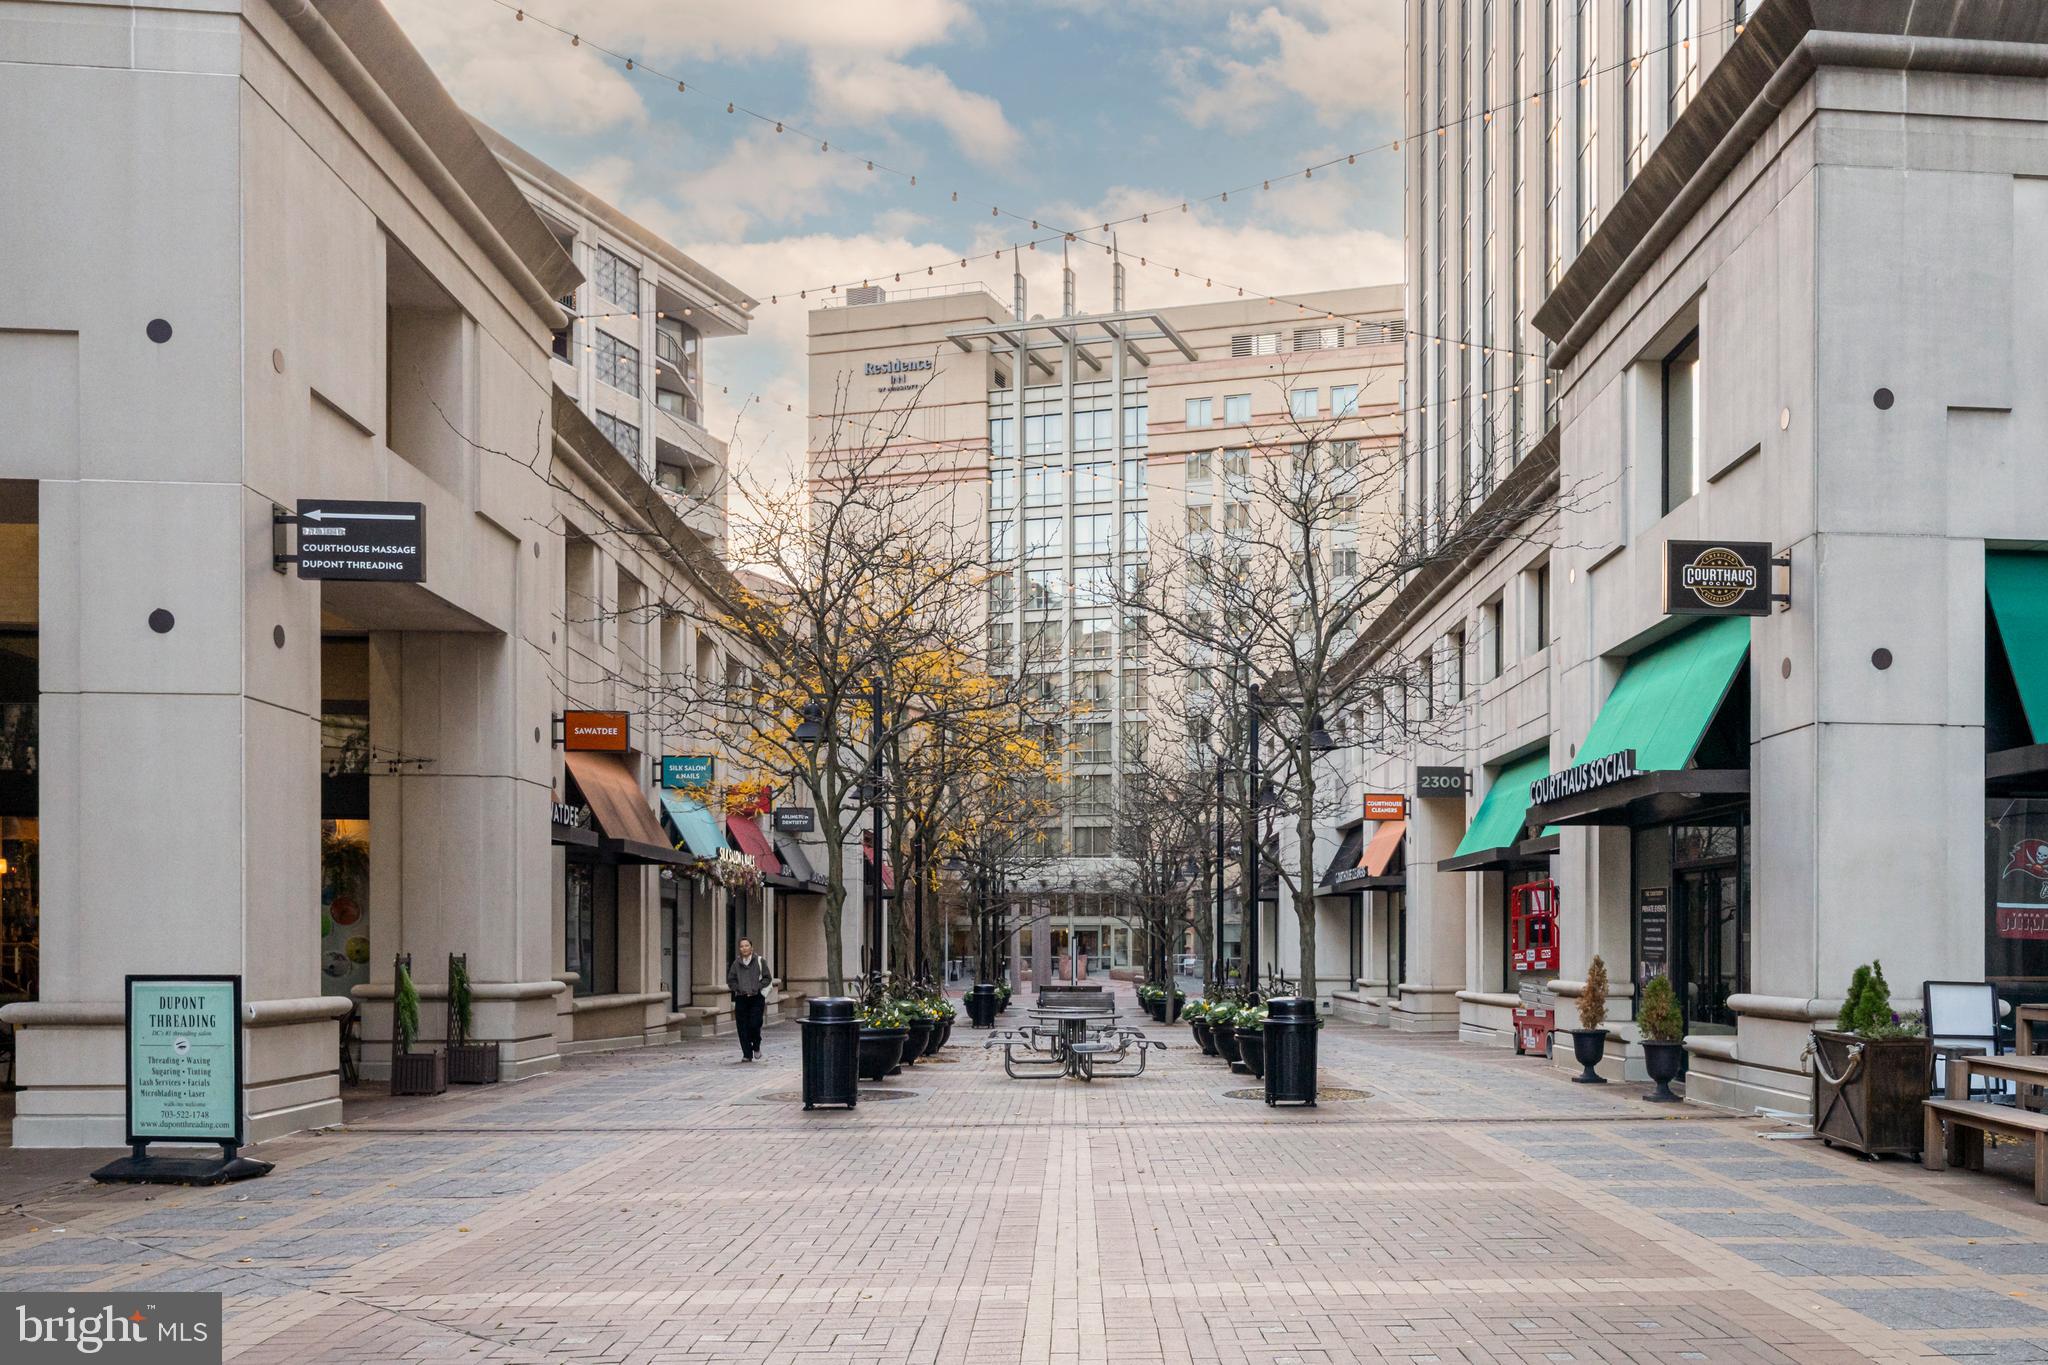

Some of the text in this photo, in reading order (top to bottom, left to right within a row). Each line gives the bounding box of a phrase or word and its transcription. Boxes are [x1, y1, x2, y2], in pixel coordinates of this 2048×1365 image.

[864, 358, 932, 376] Residence
[303, 543, 416, 554] COURTHOUSE MASSAGE
[303, 560, 403, 570] DUPONT THREADING
[1687, 568, 1753, 586] COURTHAUS
[574, 727, 618, 735] SAWATDEE
[1421, 776, 1461, 788] 2300
[1530, 749, 1632, 806] COURTHAUS SOCIAL
[159, 996, 206, 1010] DUPONT
[149, 1014, 217, 1028] THREADING
[148, 1056, 211, 1067] Threading Waxing
[152, 1067, 212, 1077] Sugaring Tinting
[139, 1078, 210, 1087] Lash Services Facials
[140, 1089, 205, 1099] Microblading Laser
[161, 1110, 210, 1119] 703-522-1748
[140, 1120, 230, 1130] www.dupontthreading.com
